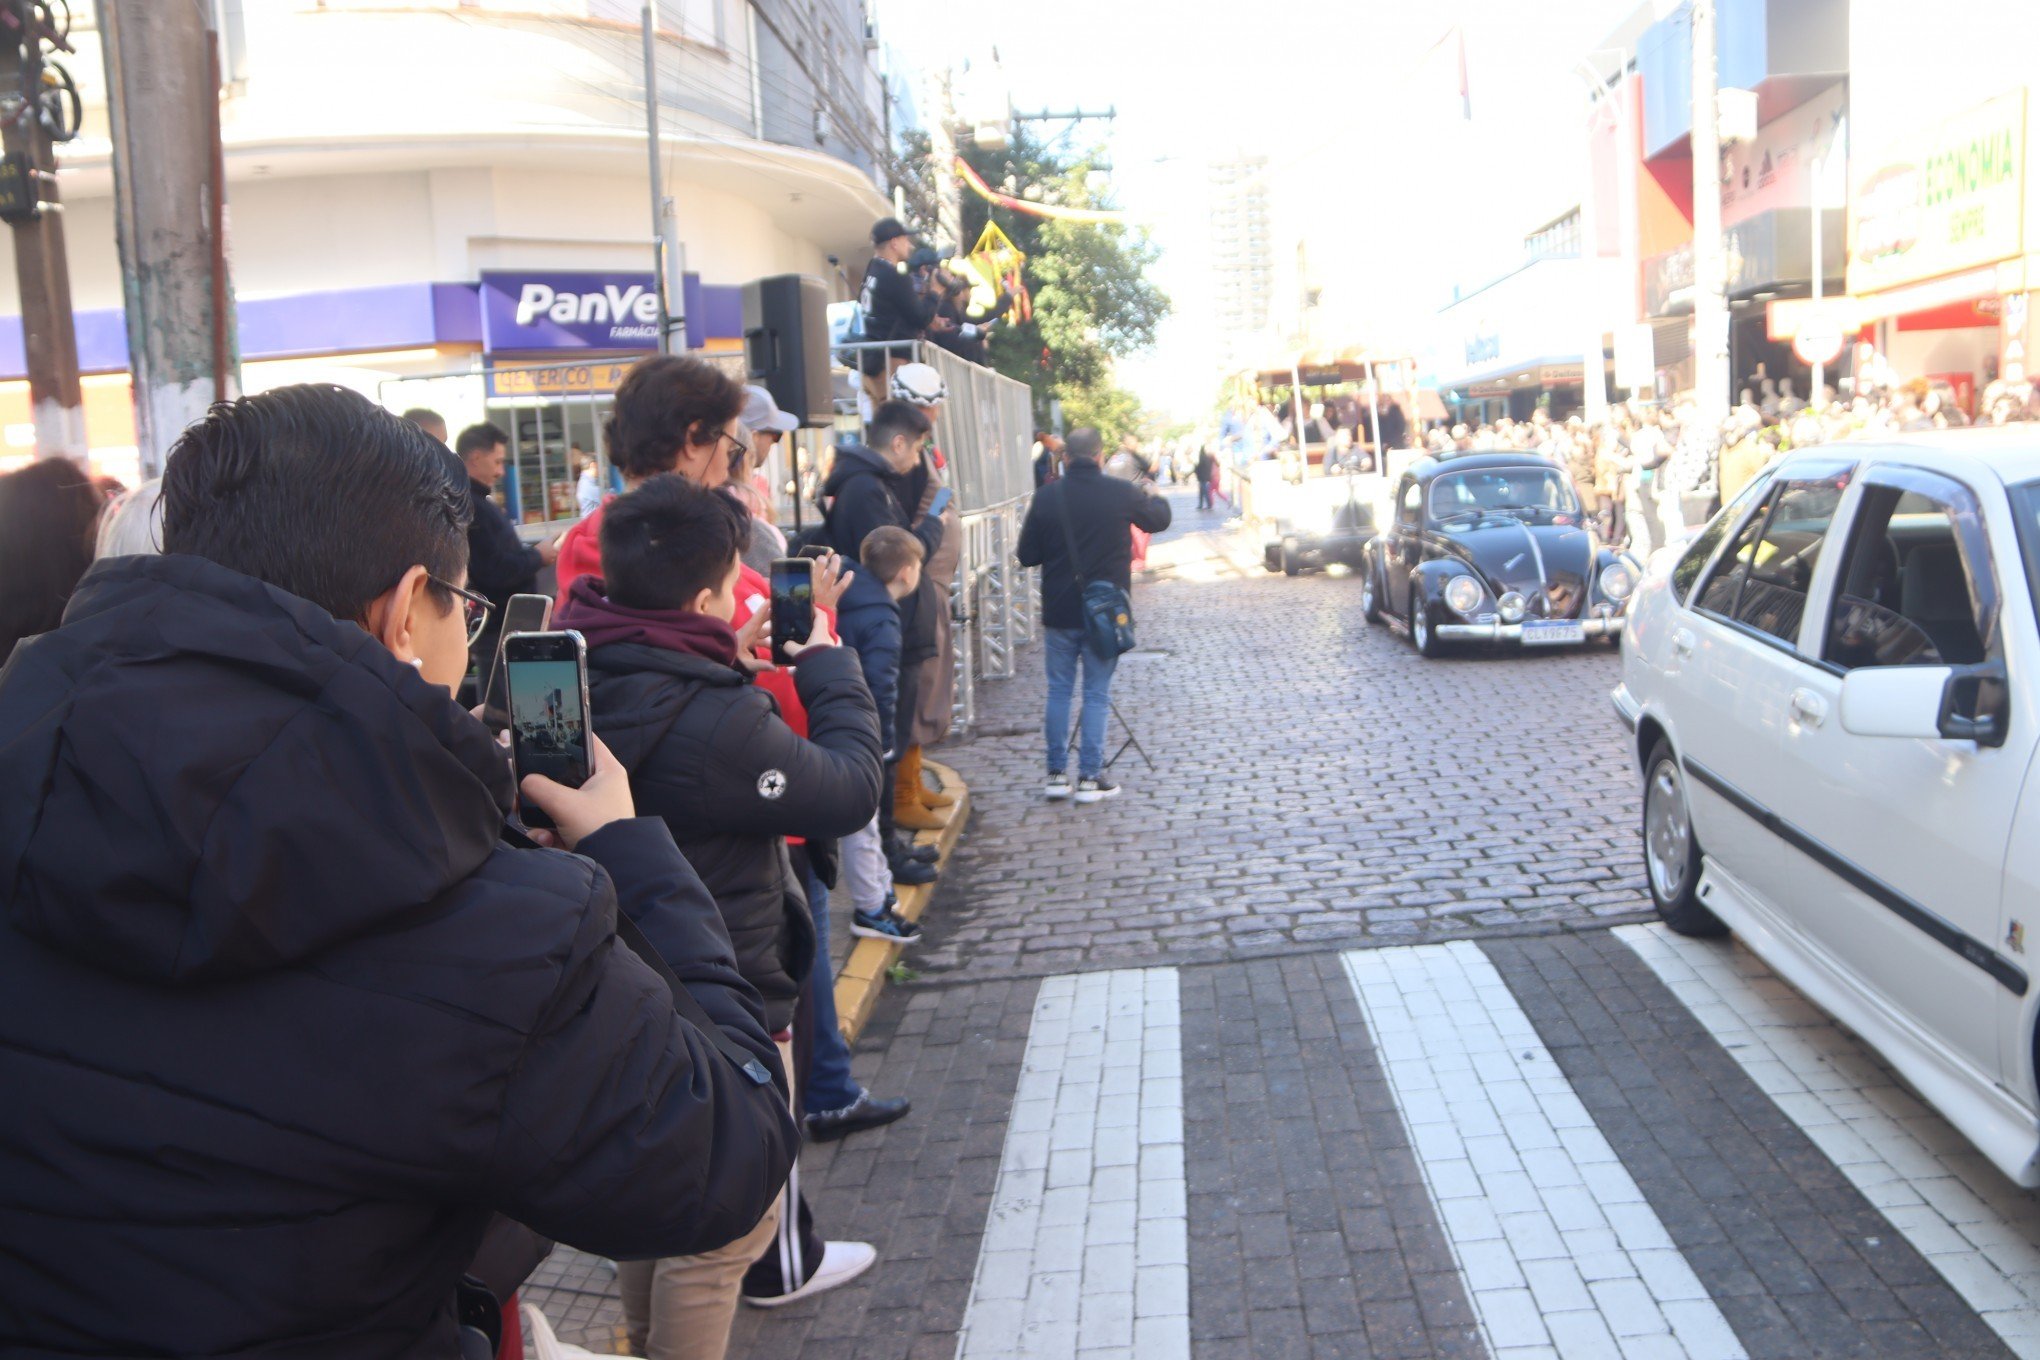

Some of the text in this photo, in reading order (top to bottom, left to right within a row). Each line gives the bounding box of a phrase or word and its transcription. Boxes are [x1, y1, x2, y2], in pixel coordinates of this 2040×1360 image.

[1925, 127, 2013, 207] ECONOMIA
[516, 283, 658, 325] PanVe
[609, 324, 661, 338] FARMÁCIA
